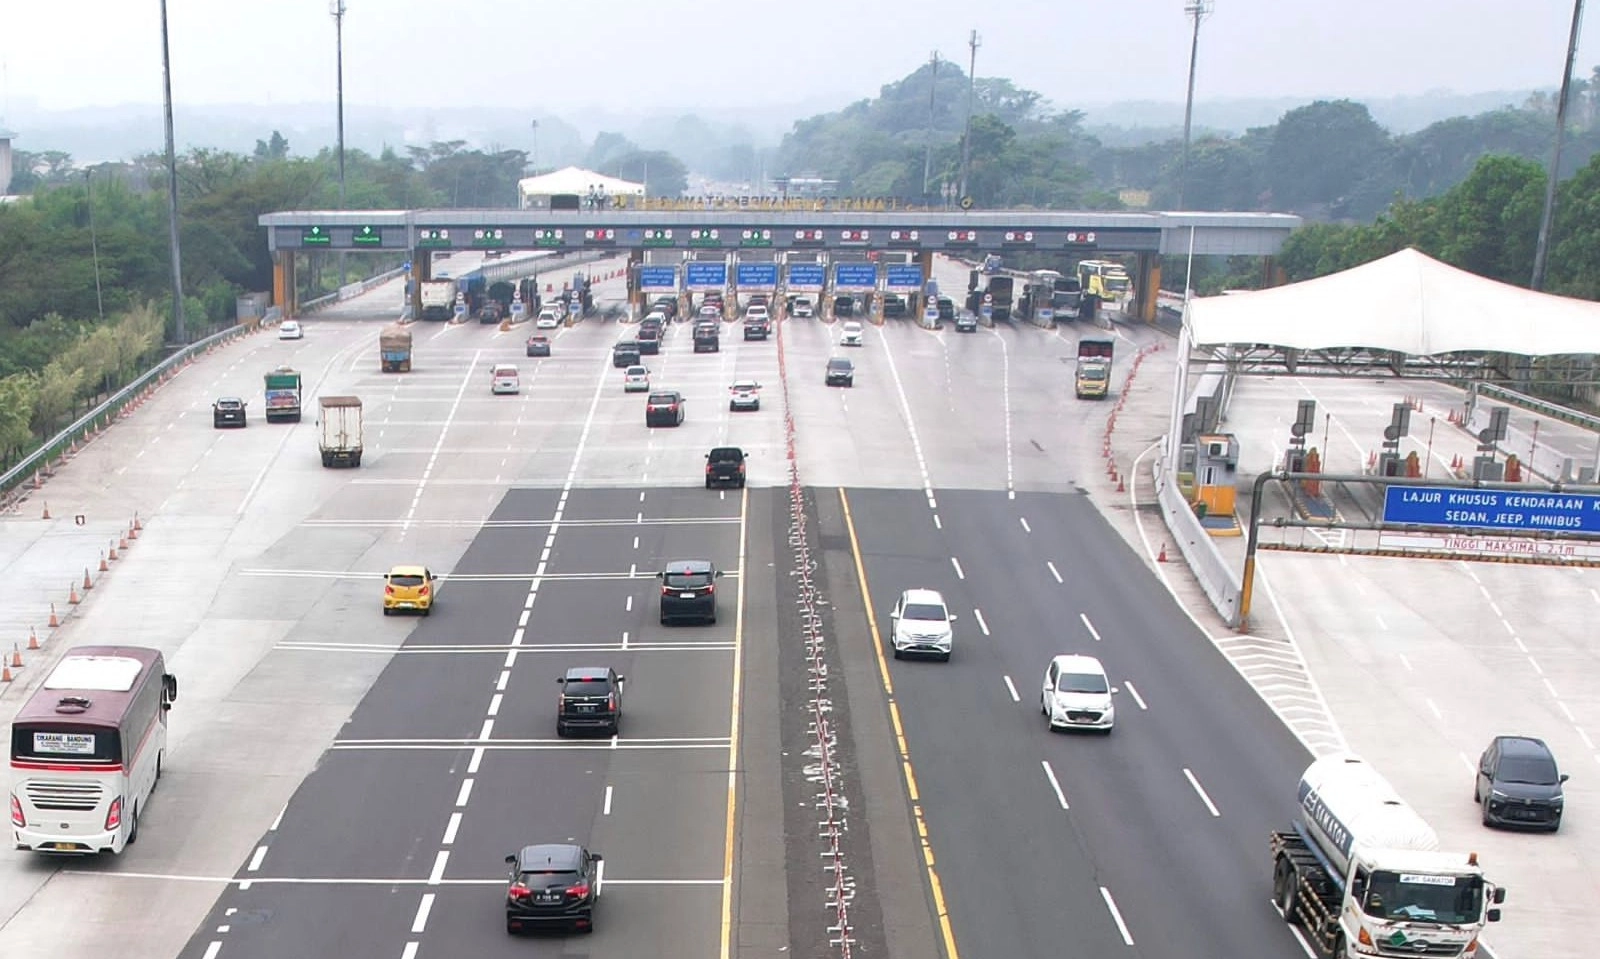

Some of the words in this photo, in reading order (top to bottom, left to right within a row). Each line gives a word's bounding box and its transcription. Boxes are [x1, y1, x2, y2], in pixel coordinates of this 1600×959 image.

[1403, 491, 1441, 503] LAJUR
[1449, 493, 1497, 506] KHUSUS
[1505, 496, 1583, 510] KENDARAAN
[1445, 510, 1490, 524] SEDAN,
[1493, 512, 1525, 525] JEEP,
[1530, 515, 1582, 527] MINIBUS
[1443, 538, 1479, 550] TINGGI
[1485, 539, 1541, 554] MAKSIMAL
[1315, 803, 1347, 850] SAMATOR
[1423, 876, 1454, 884] SAMATOR
